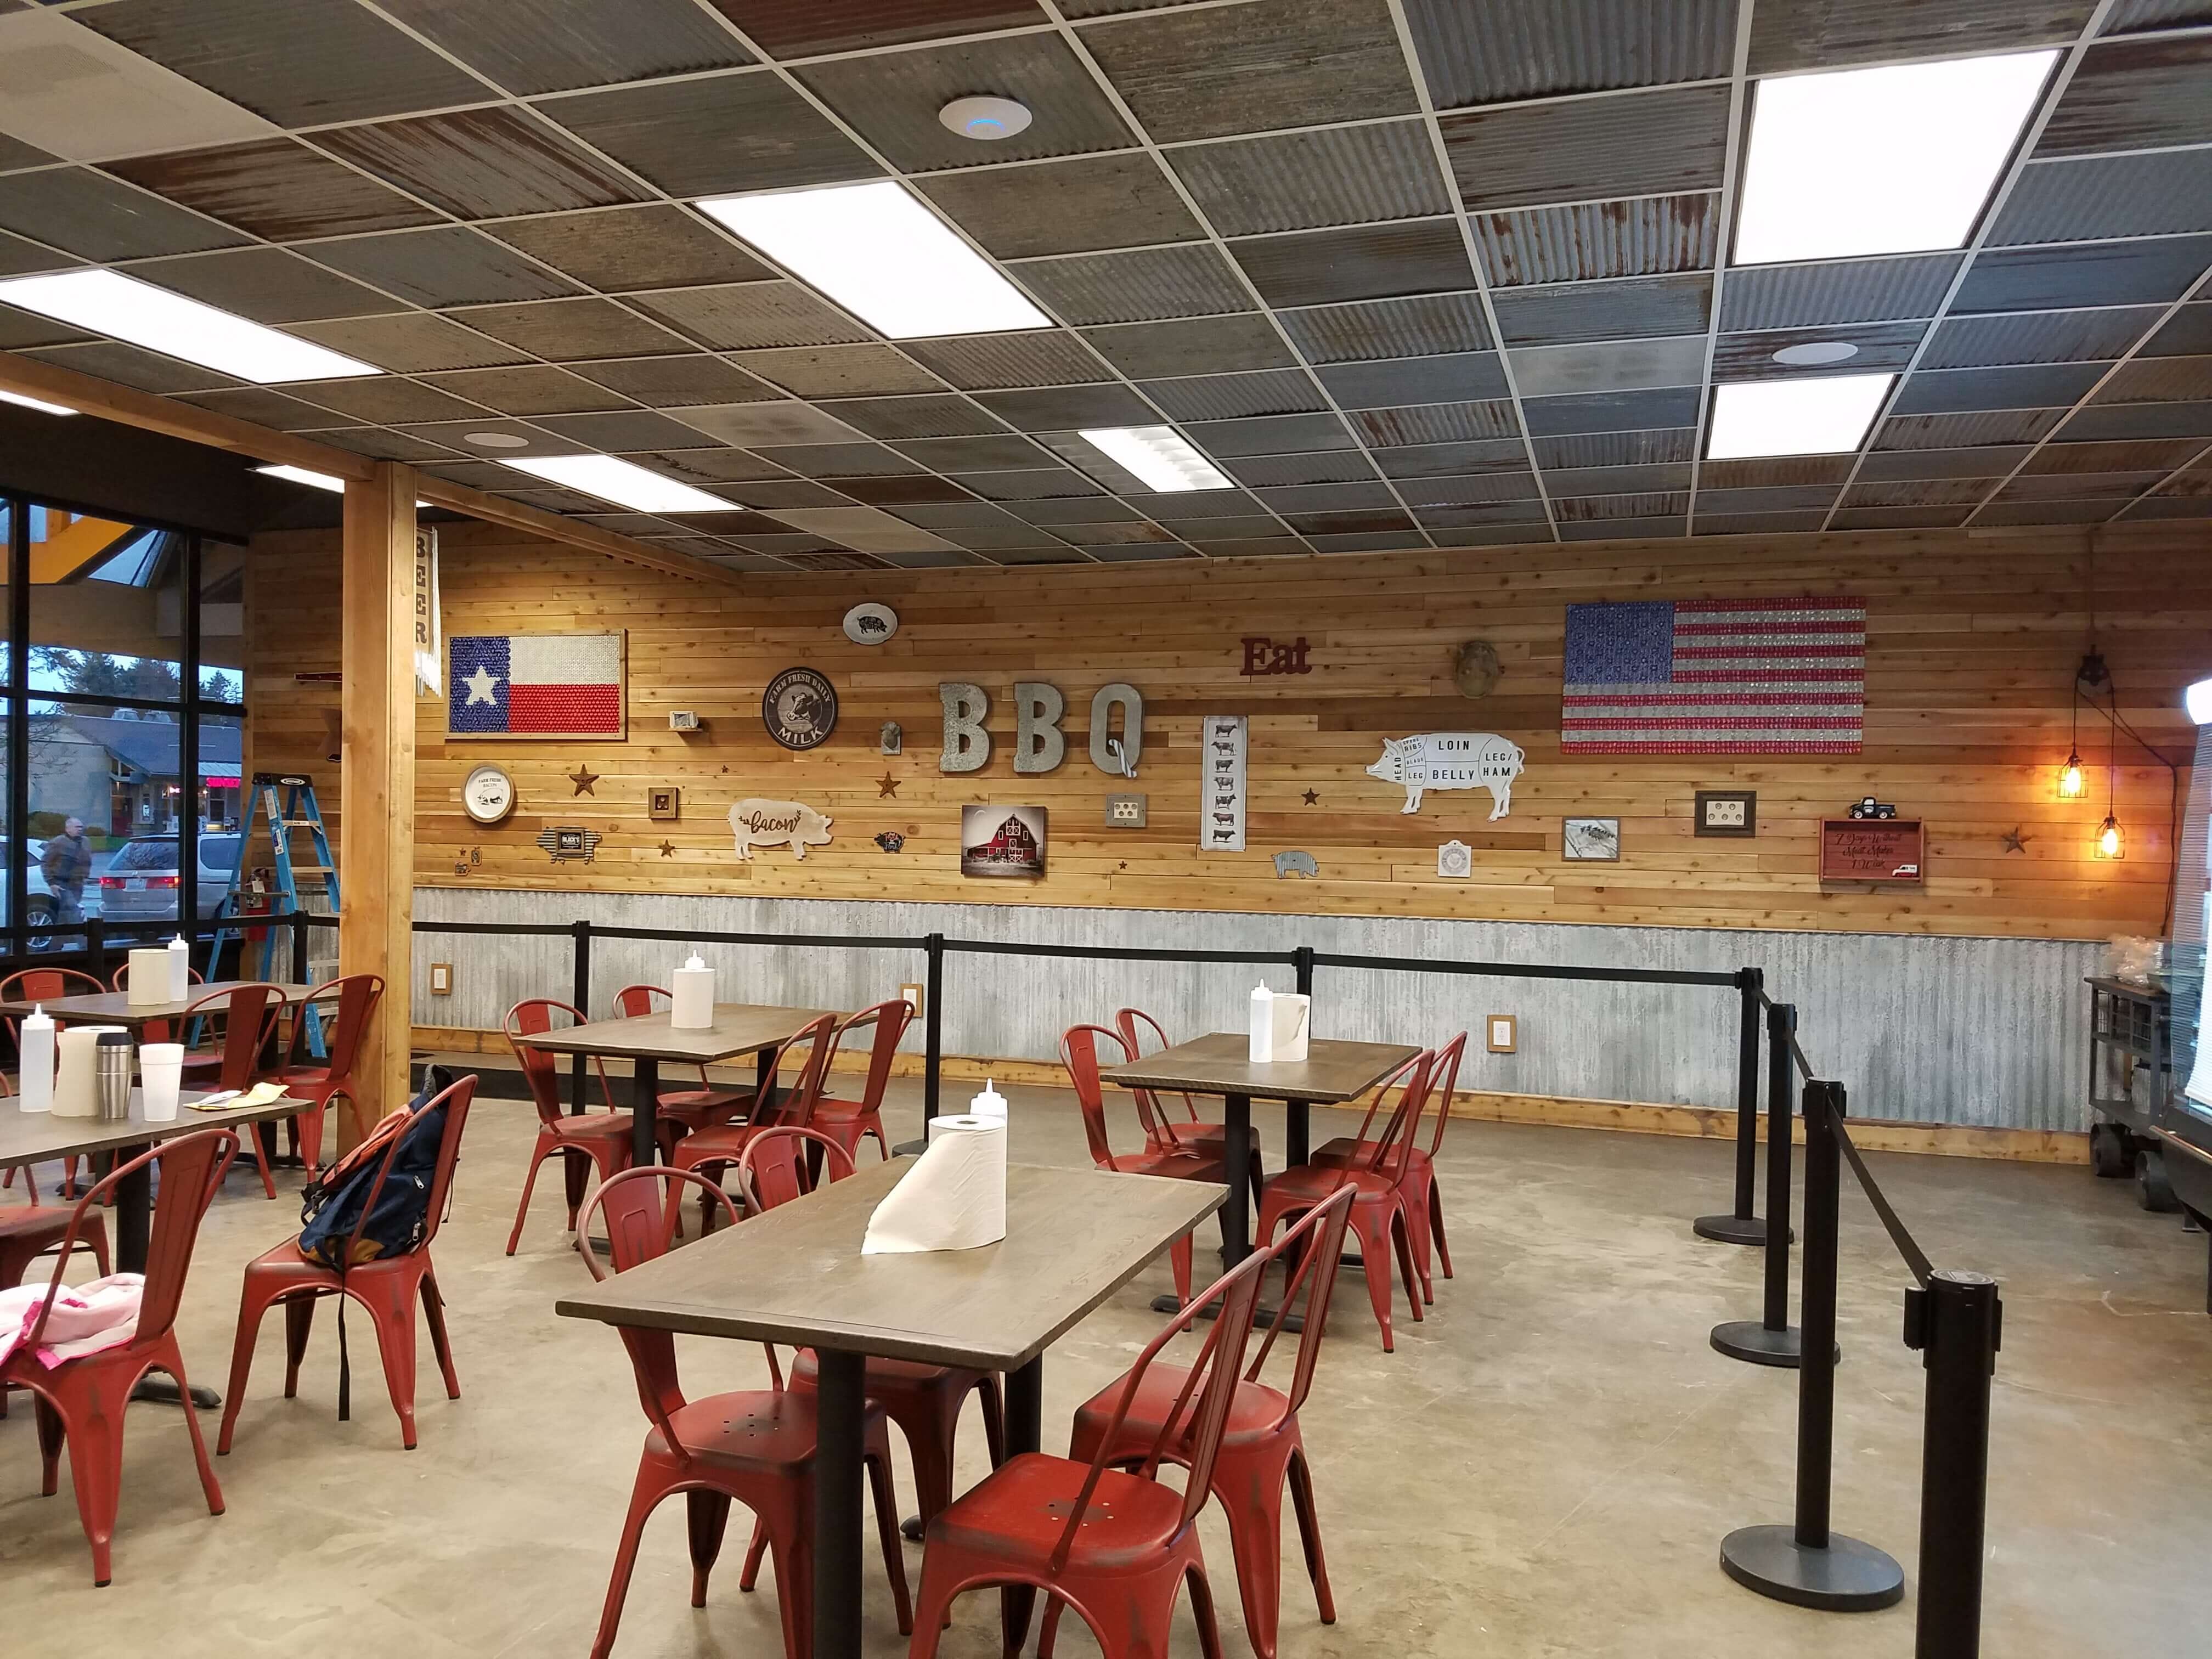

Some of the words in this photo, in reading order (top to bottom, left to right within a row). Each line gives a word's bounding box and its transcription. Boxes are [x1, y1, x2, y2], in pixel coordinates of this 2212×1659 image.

[1240, 637, 1312, 676] Eat
[769, 679, 787, 704] FARM
[788, 673, 811, 684] FRESH
[812, 678, 831, 702] DAILY
[777, 726, 823, 744] MILK
[939, 682, 1143, 777] BBQ
[1404, 742, 1422, 752] RIBS
[1438, 740, 1470, 751] LOIN
[1432, 770, 1475, 780] BELLY
[1483, 767, 1510, 777] HAM
[747, 810, 798, 834] bacon
[1835, 833, 1844, 845] 7
